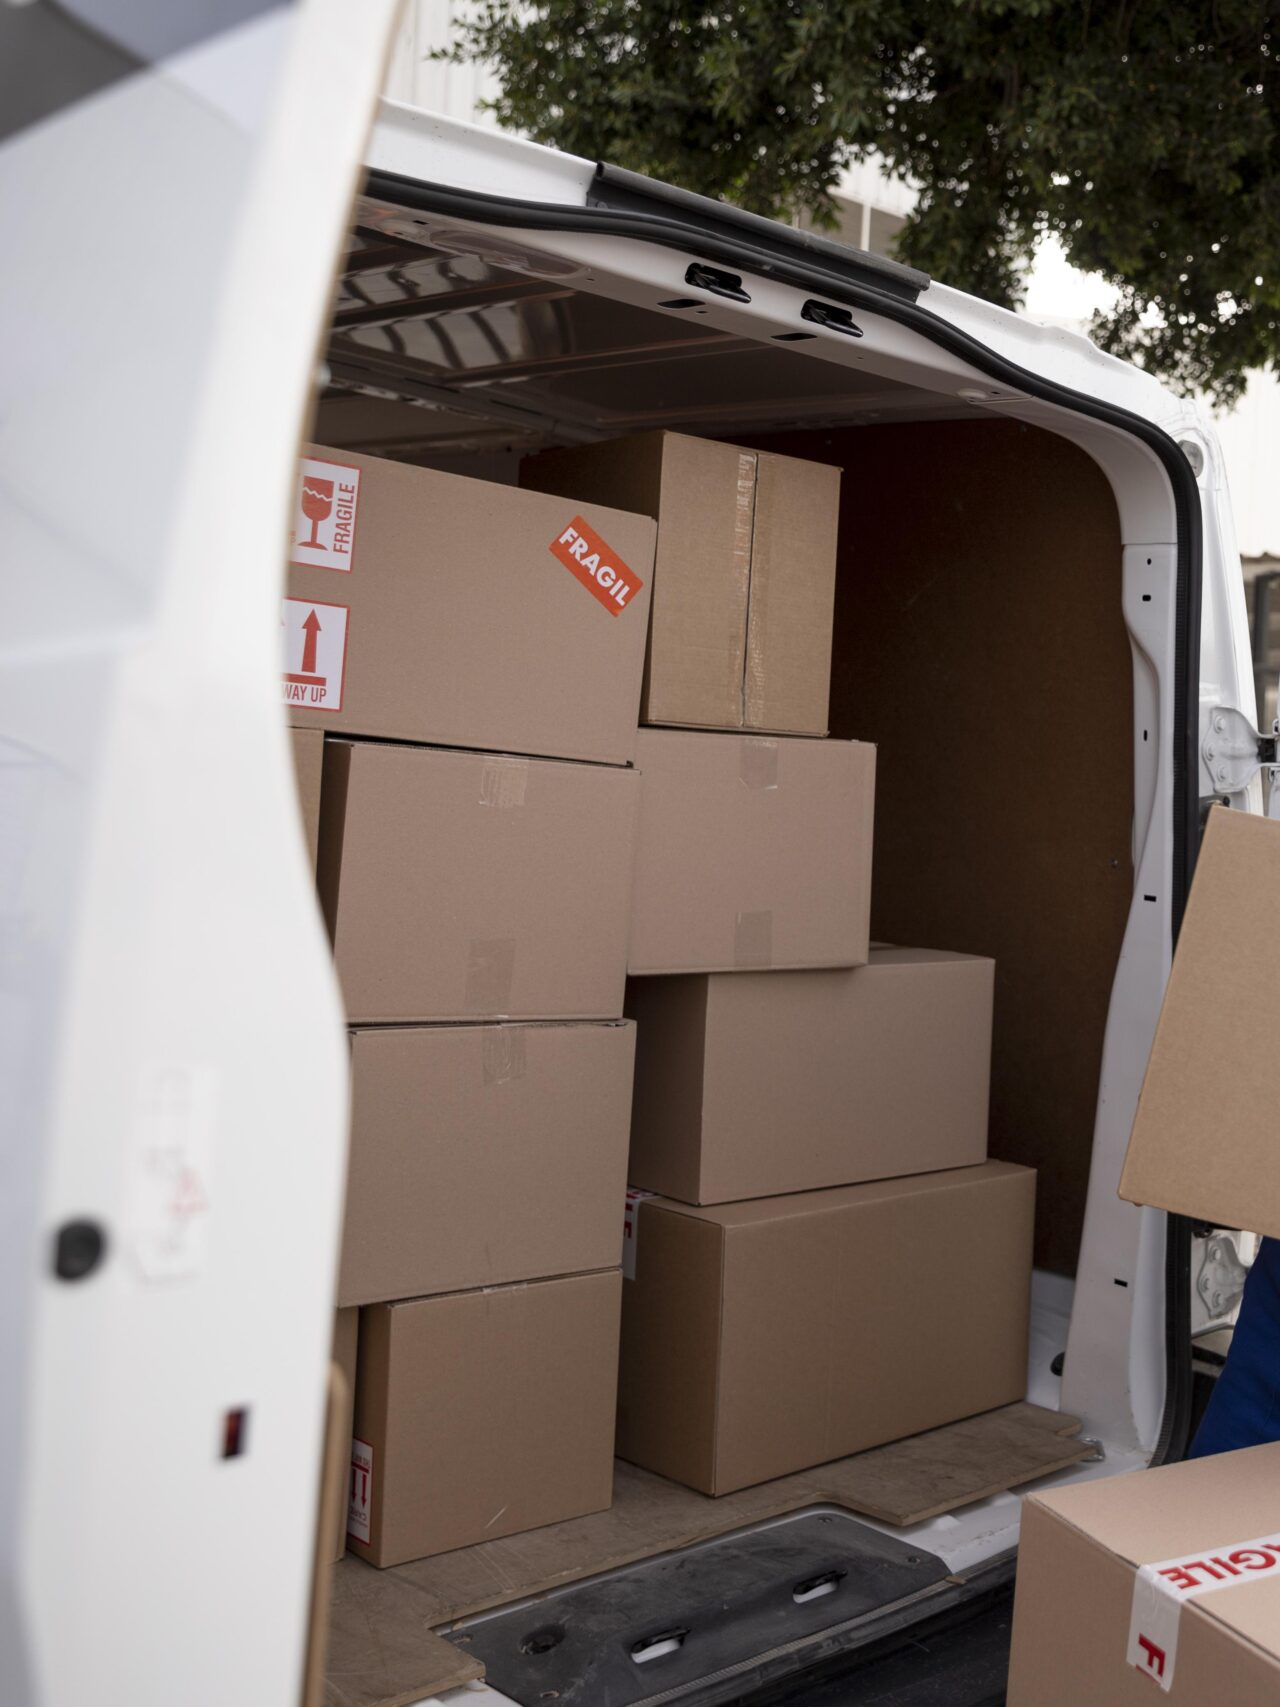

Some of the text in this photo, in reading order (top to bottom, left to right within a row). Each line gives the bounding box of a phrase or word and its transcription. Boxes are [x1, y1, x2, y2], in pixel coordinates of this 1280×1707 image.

[333, 482, 355, 554] FRAGILE
[559, 527, 630, 607] FRAGIL
[311, 687, 327, 703] UP
[1136, 1632, 1166, 1685] F
